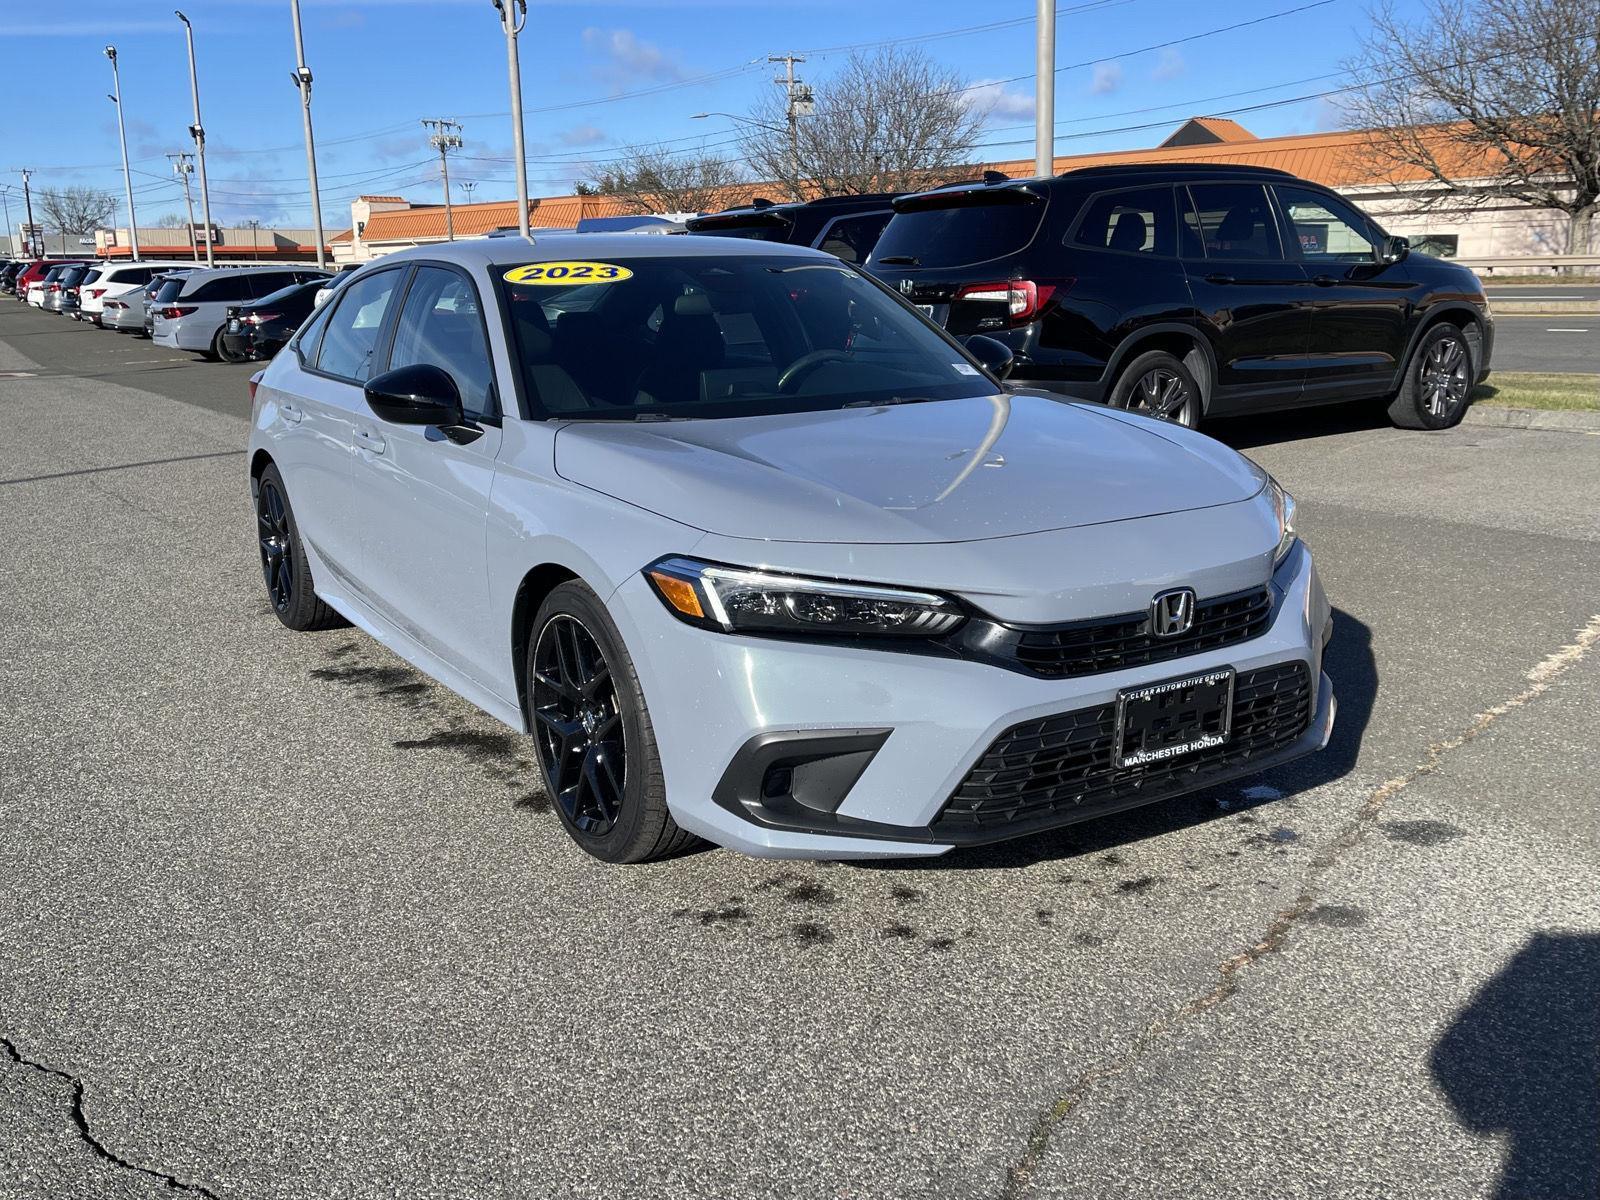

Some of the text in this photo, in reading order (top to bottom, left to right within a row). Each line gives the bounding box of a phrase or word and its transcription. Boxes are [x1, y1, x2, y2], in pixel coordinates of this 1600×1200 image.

[520, 266, 619, 281] 2023
[1130, 671, 1230, 700] CLEAR AUTOMOTIVE GROUP
[1124, 736, 1224, 767] MANCHESTER HONDA
